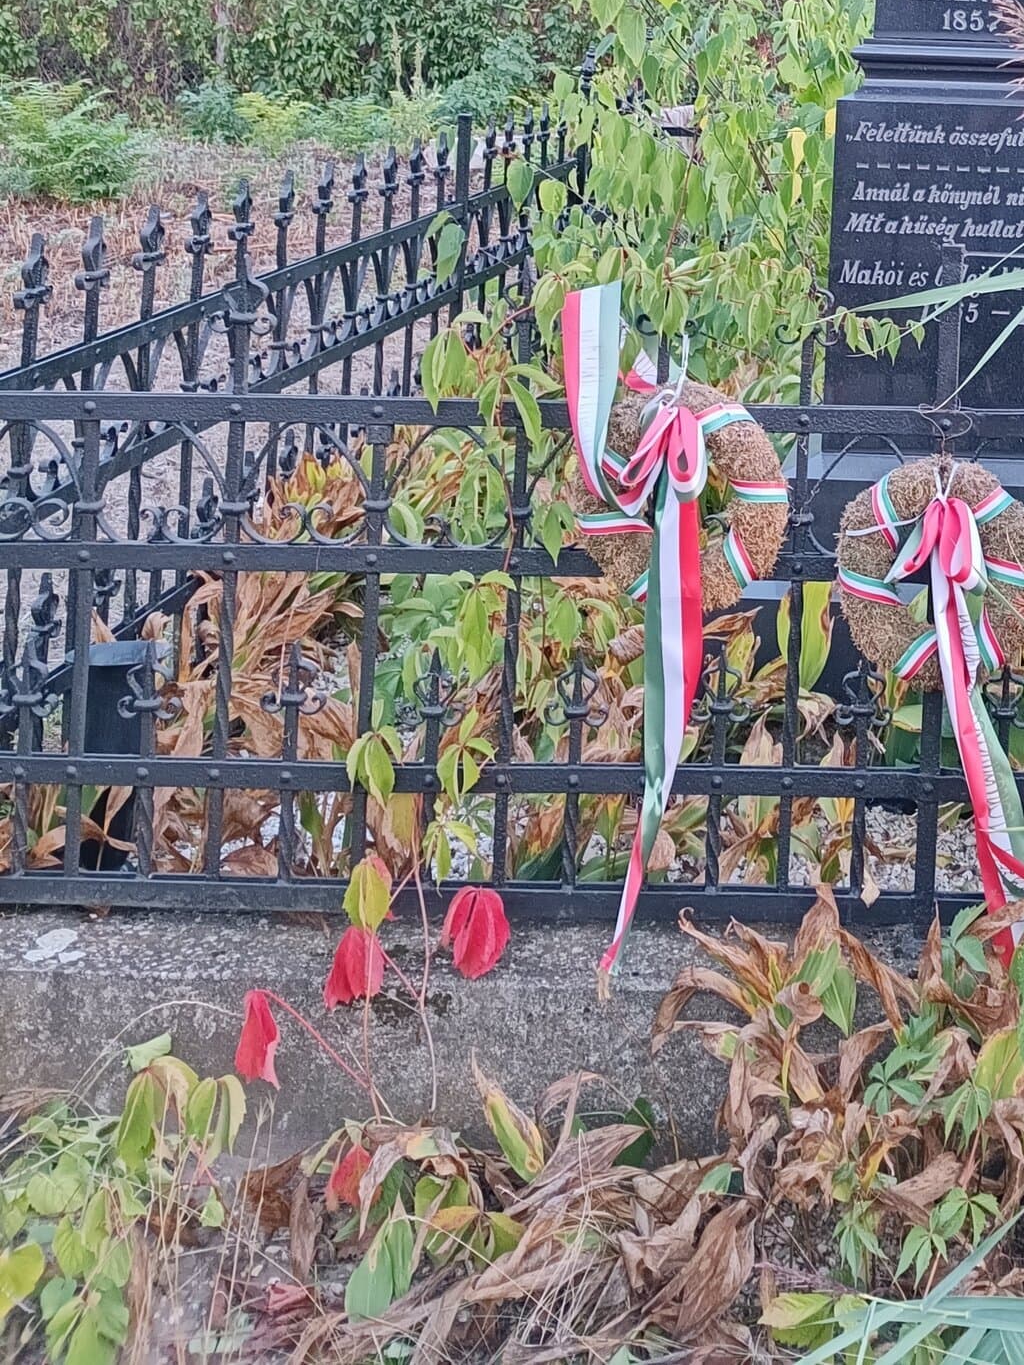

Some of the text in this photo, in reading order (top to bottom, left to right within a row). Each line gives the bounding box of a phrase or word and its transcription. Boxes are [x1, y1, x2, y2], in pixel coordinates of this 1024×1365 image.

[851, 180, 910, 203] Annál
[912, 188, 926, 203] a
[843, 211, 886, 234] Mit
